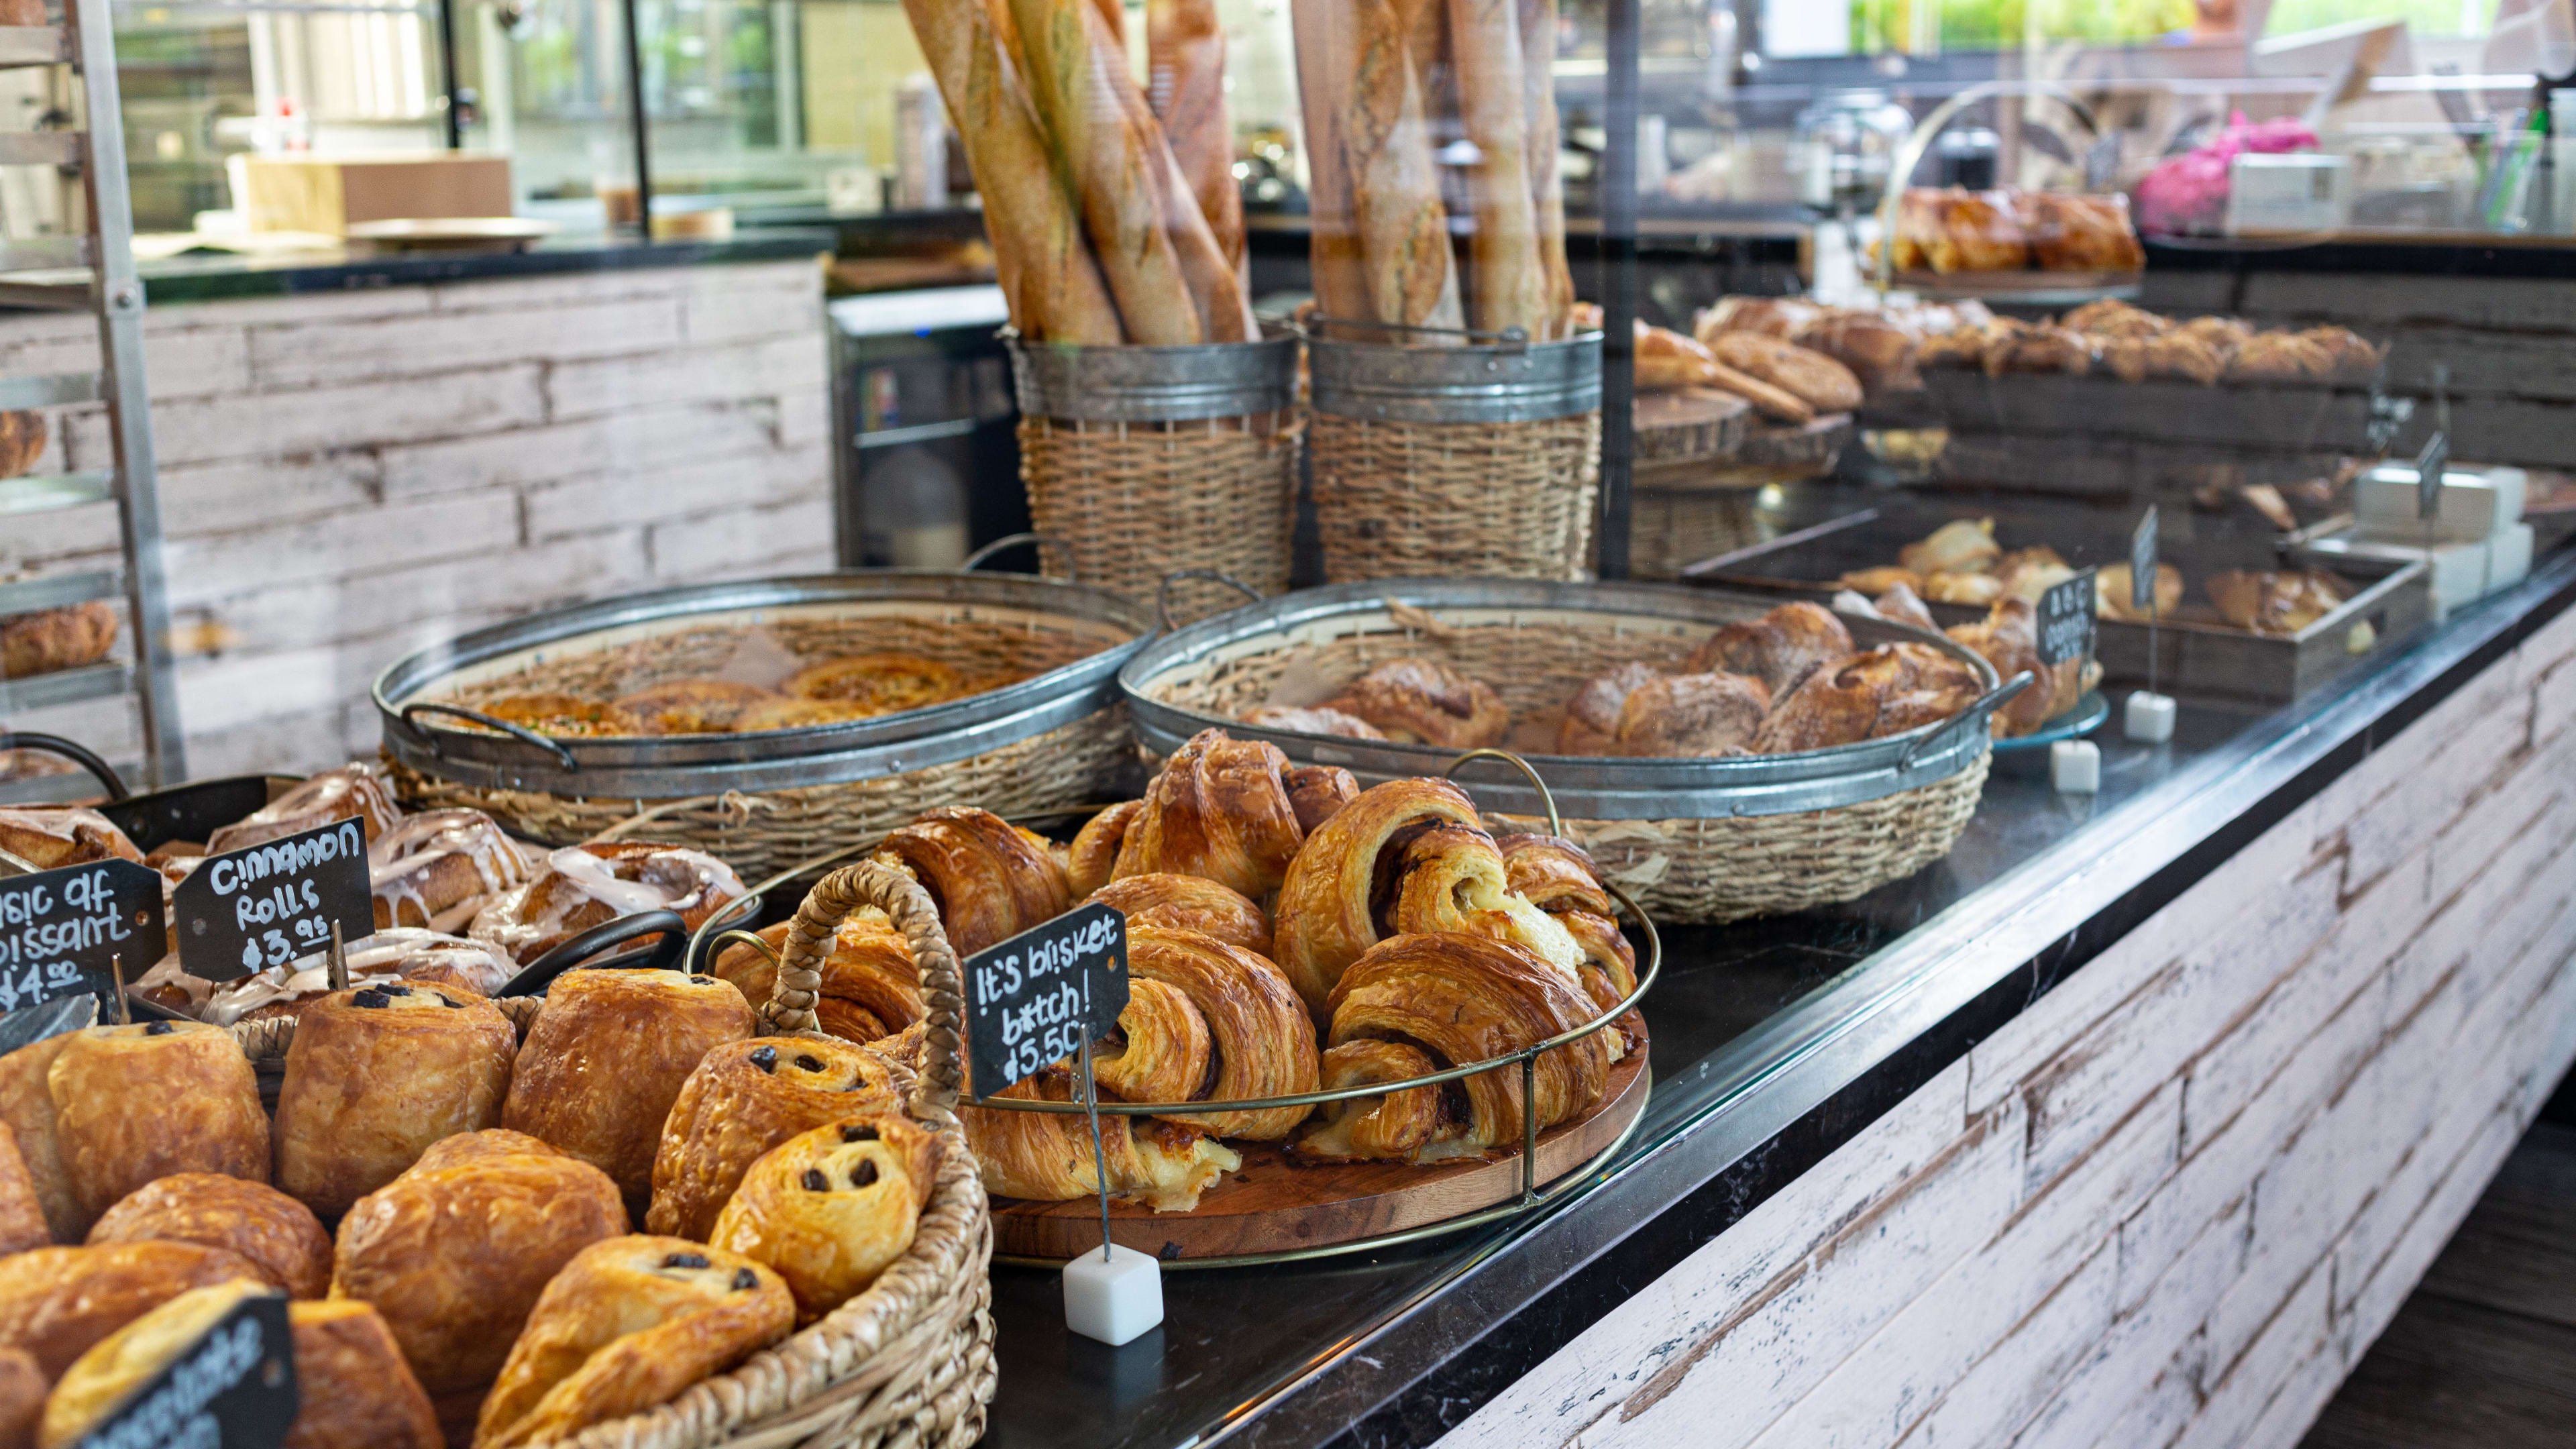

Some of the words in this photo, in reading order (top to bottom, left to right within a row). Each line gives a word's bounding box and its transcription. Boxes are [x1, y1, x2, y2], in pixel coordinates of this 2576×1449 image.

[210, 822, 360, 896] Cinnamon
[0, 885, 54, 929] sic
[1028, 914, 1118, 979] brisket
[1004, 1020, 1081, 1085] $5.50
